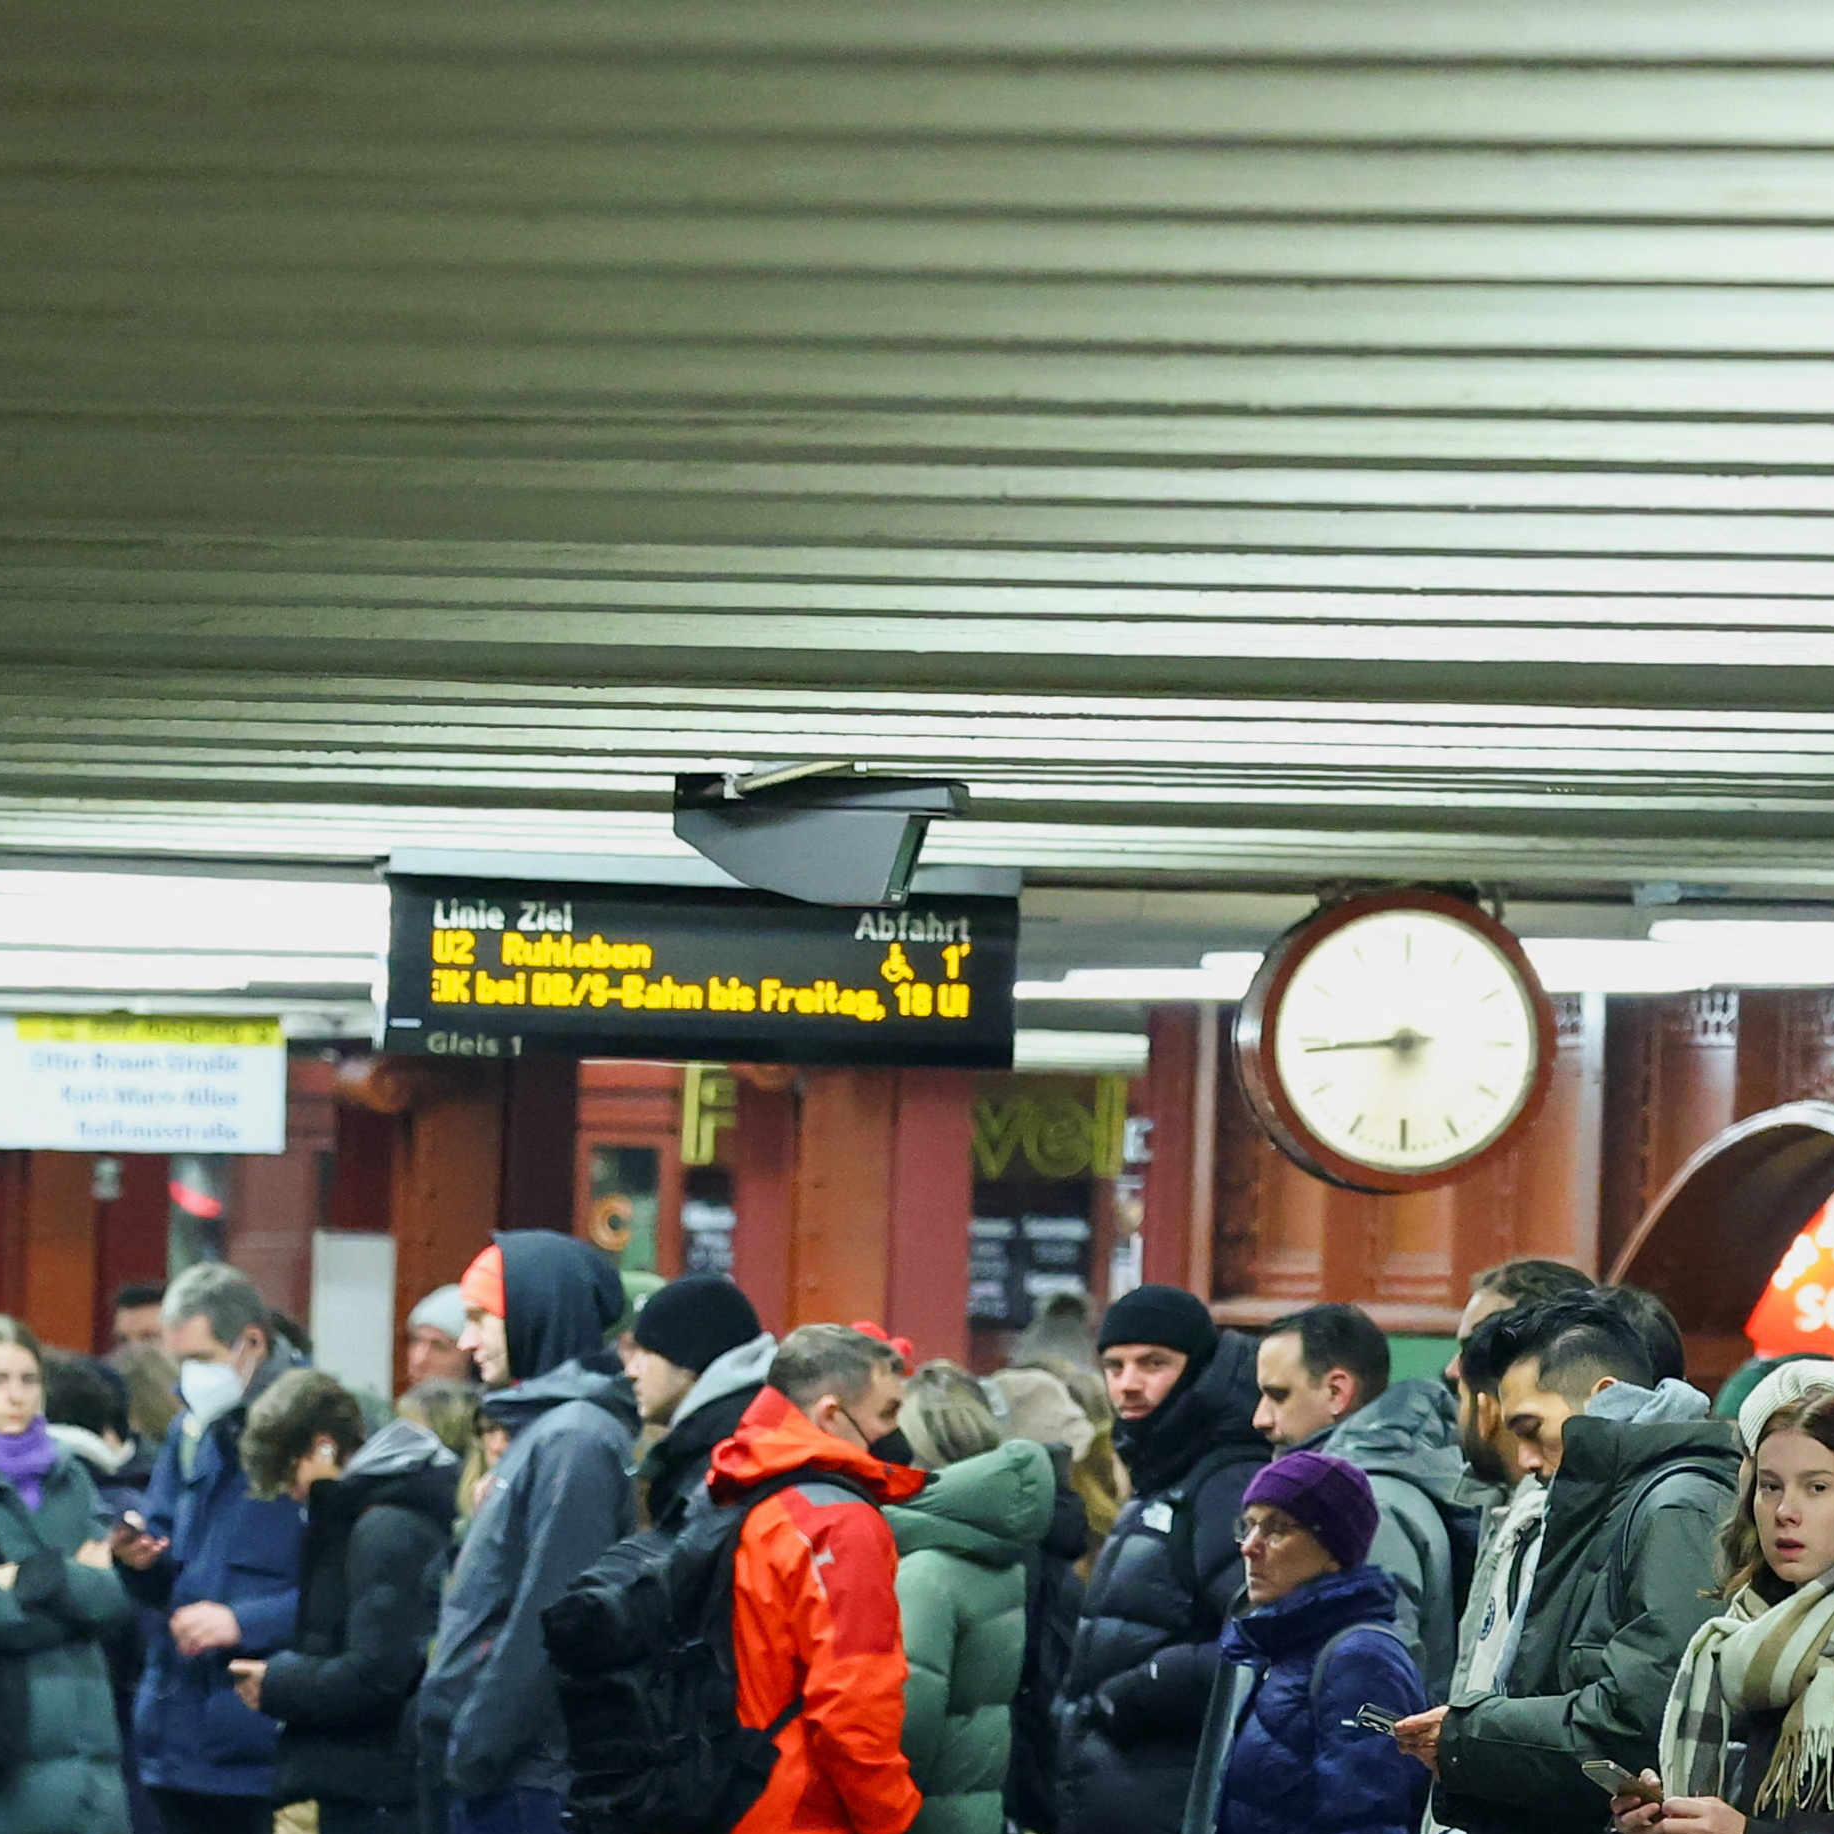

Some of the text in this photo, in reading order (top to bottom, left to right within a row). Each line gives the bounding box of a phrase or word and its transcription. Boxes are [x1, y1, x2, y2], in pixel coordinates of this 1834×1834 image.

[433, 898, 971, 943] Linie Ziel Abfahrt
[432, 929, 476, 965] U2
[501, 931, 654, 970] Ruhleben
[475, 970, 526, 1005] bei
[531, 971, 704, 1011] DB/S-Bahn
[708, 976, 756, 1013] bis
[760, 977, 887, 1022] Freitag,
[894, 981, 933, 1017] 18
[426, 1030, 523, 1057] Gleis 1
